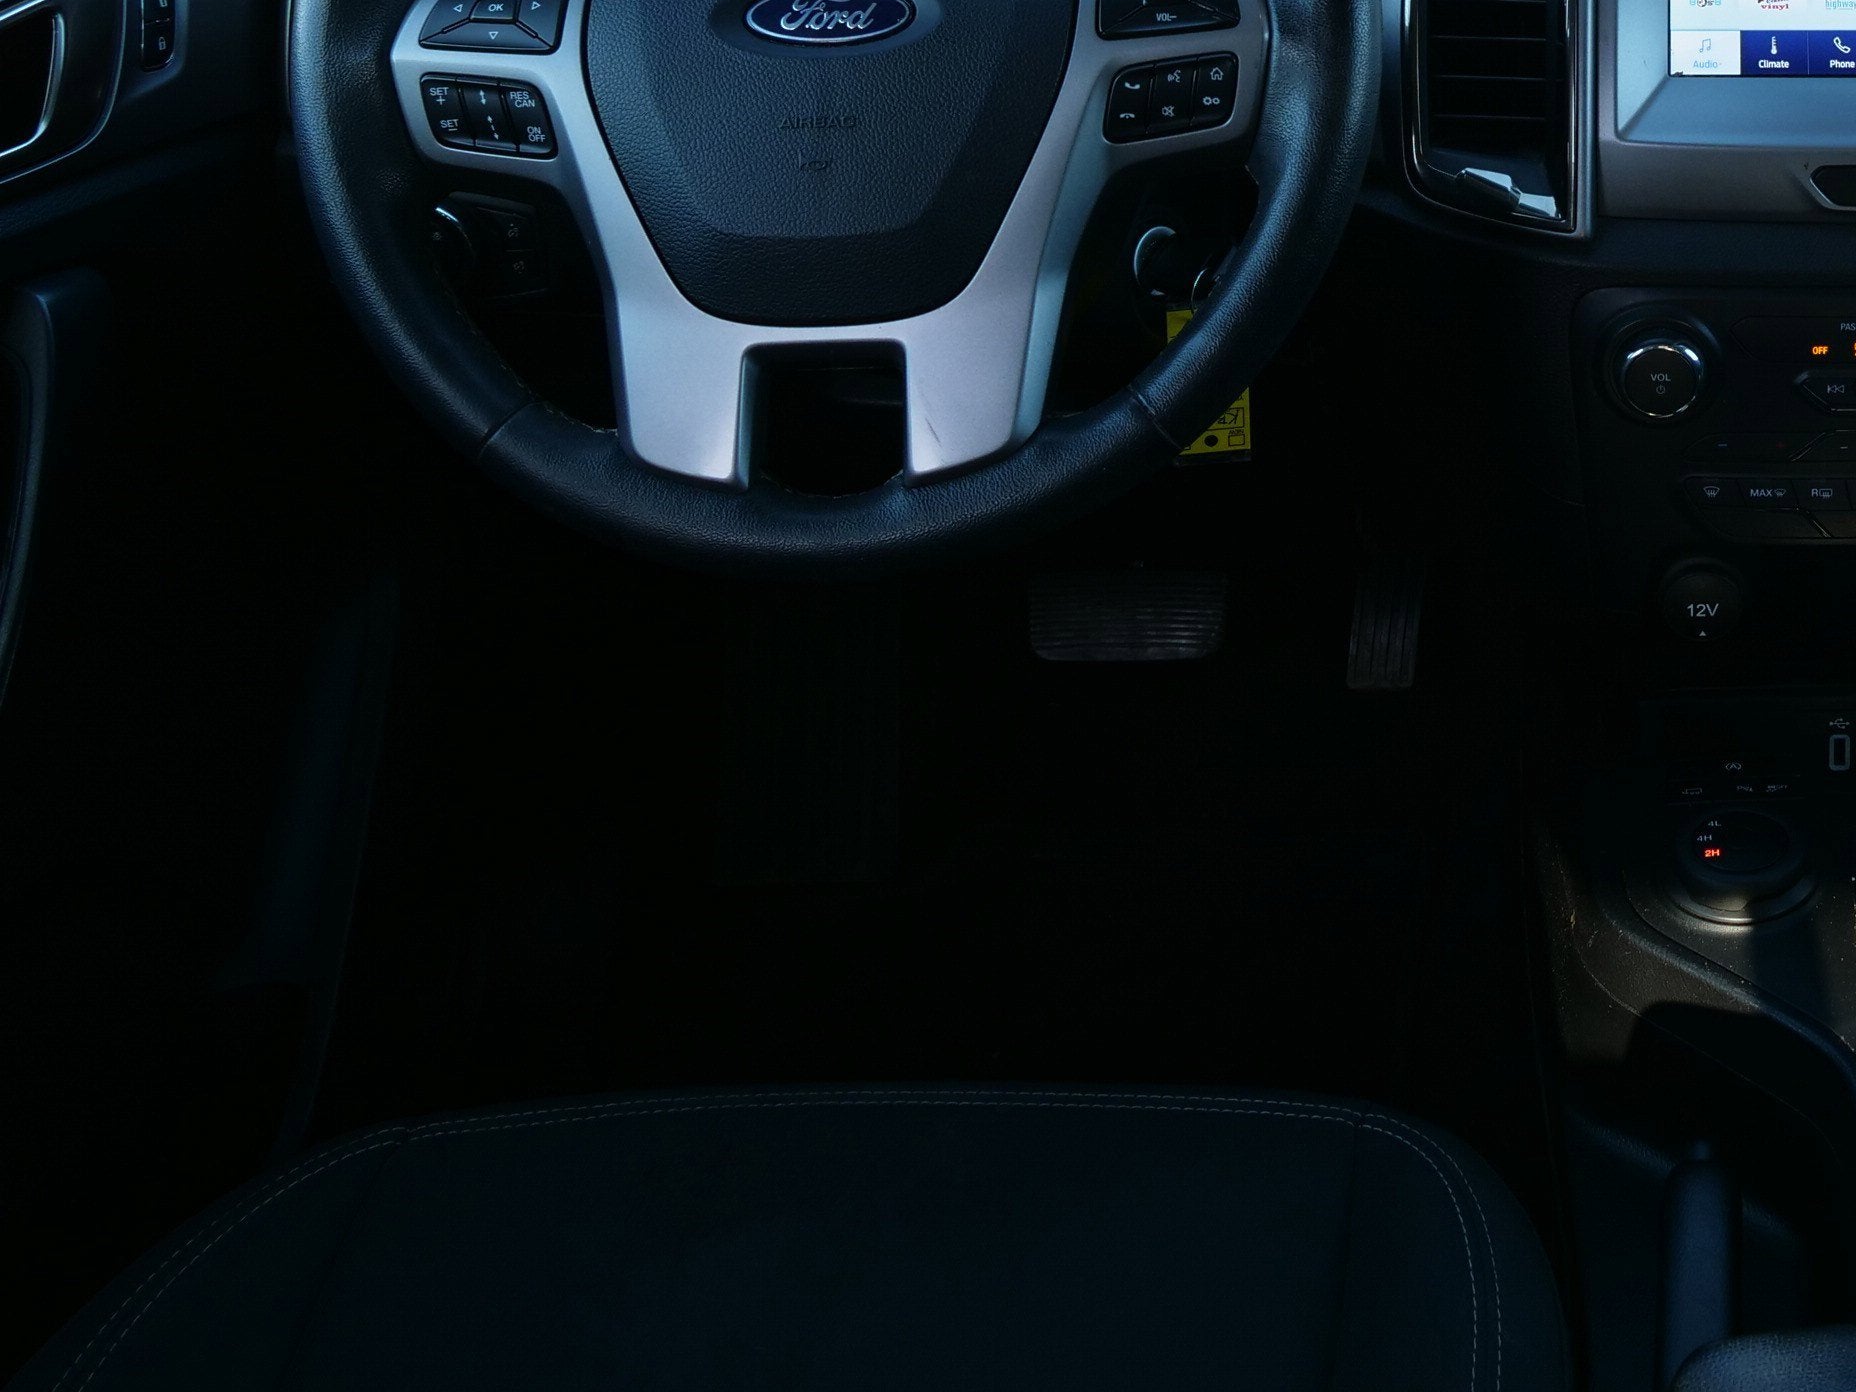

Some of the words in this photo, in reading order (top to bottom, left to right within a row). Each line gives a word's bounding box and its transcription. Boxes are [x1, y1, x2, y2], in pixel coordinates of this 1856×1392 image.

[488, 3, 505, 12] OK
[1693, 59, 1718, 69] Audio
[1758, 59, 1790, 69] Climate
[1829, 59, 1856, 69] Phone
[429, 86, 450, 96] SET
[510, 91, 530, 101] RES
[514, 99, 536, 108] CAN
[440, 118, 459, 128] SET
[527, 126, 541, 135] ON
[529, 134, 546, 143] OFF
[1812, 346, 1829, 355] OFF
[1650, 373, 1671, 382] VOL
[1750, 488, 1773, 497] MAX
[1686, 603, 1719, 618] 12V
[1704, 848, 1720, 857] 2H
